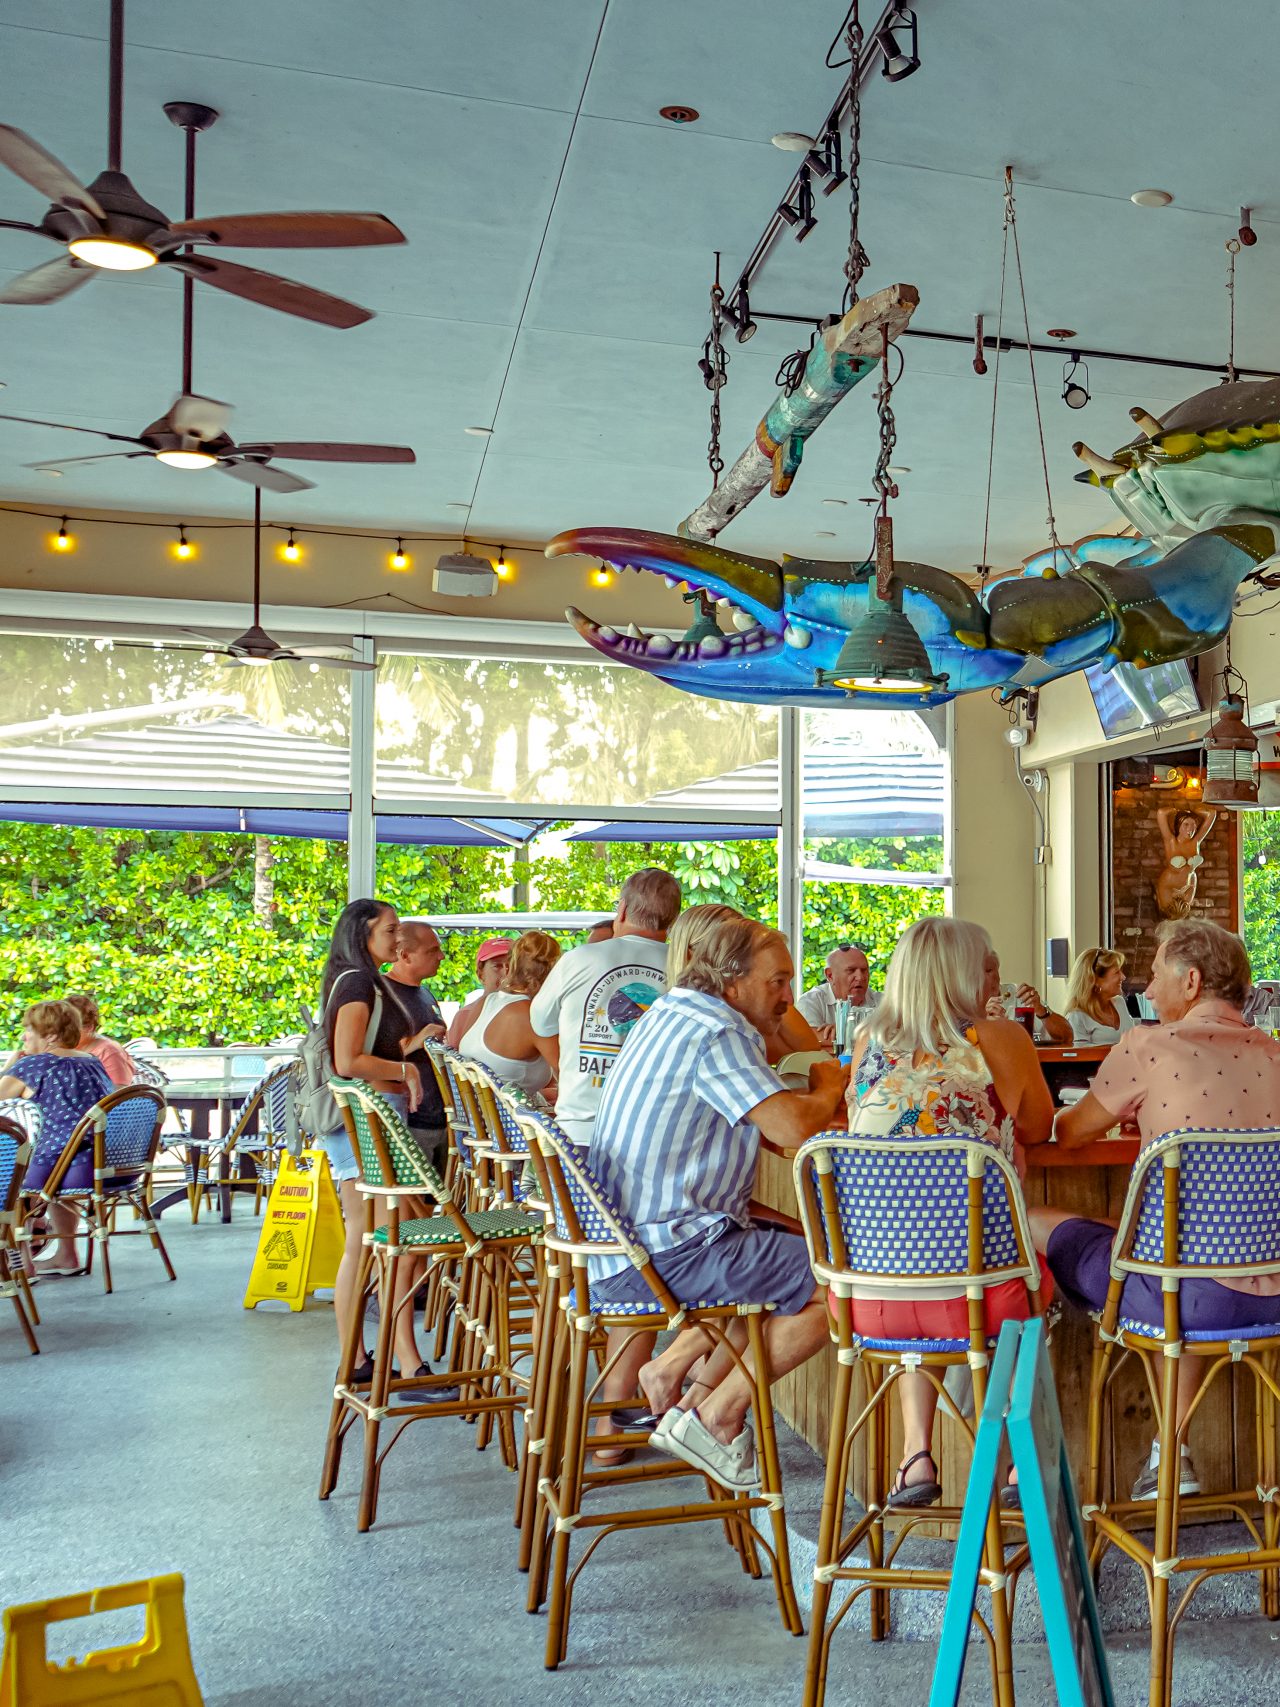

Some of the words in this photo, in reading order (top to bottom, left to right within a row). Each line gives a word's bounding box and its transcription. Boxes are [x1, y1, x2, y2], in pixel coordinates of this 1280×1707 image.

[586, 988, 604, 1028] FORWARD
[605, 968, 640, 985] UPWARD
[594, 1024, 609, 1033] 20
[588, 1032, 613, 1040] SUPPORT
[279, 1186, 308, 1197] CAUTION
[272, 1211, 285, 1219] WET
[286, 1211, 306, 1220] FLOOR
